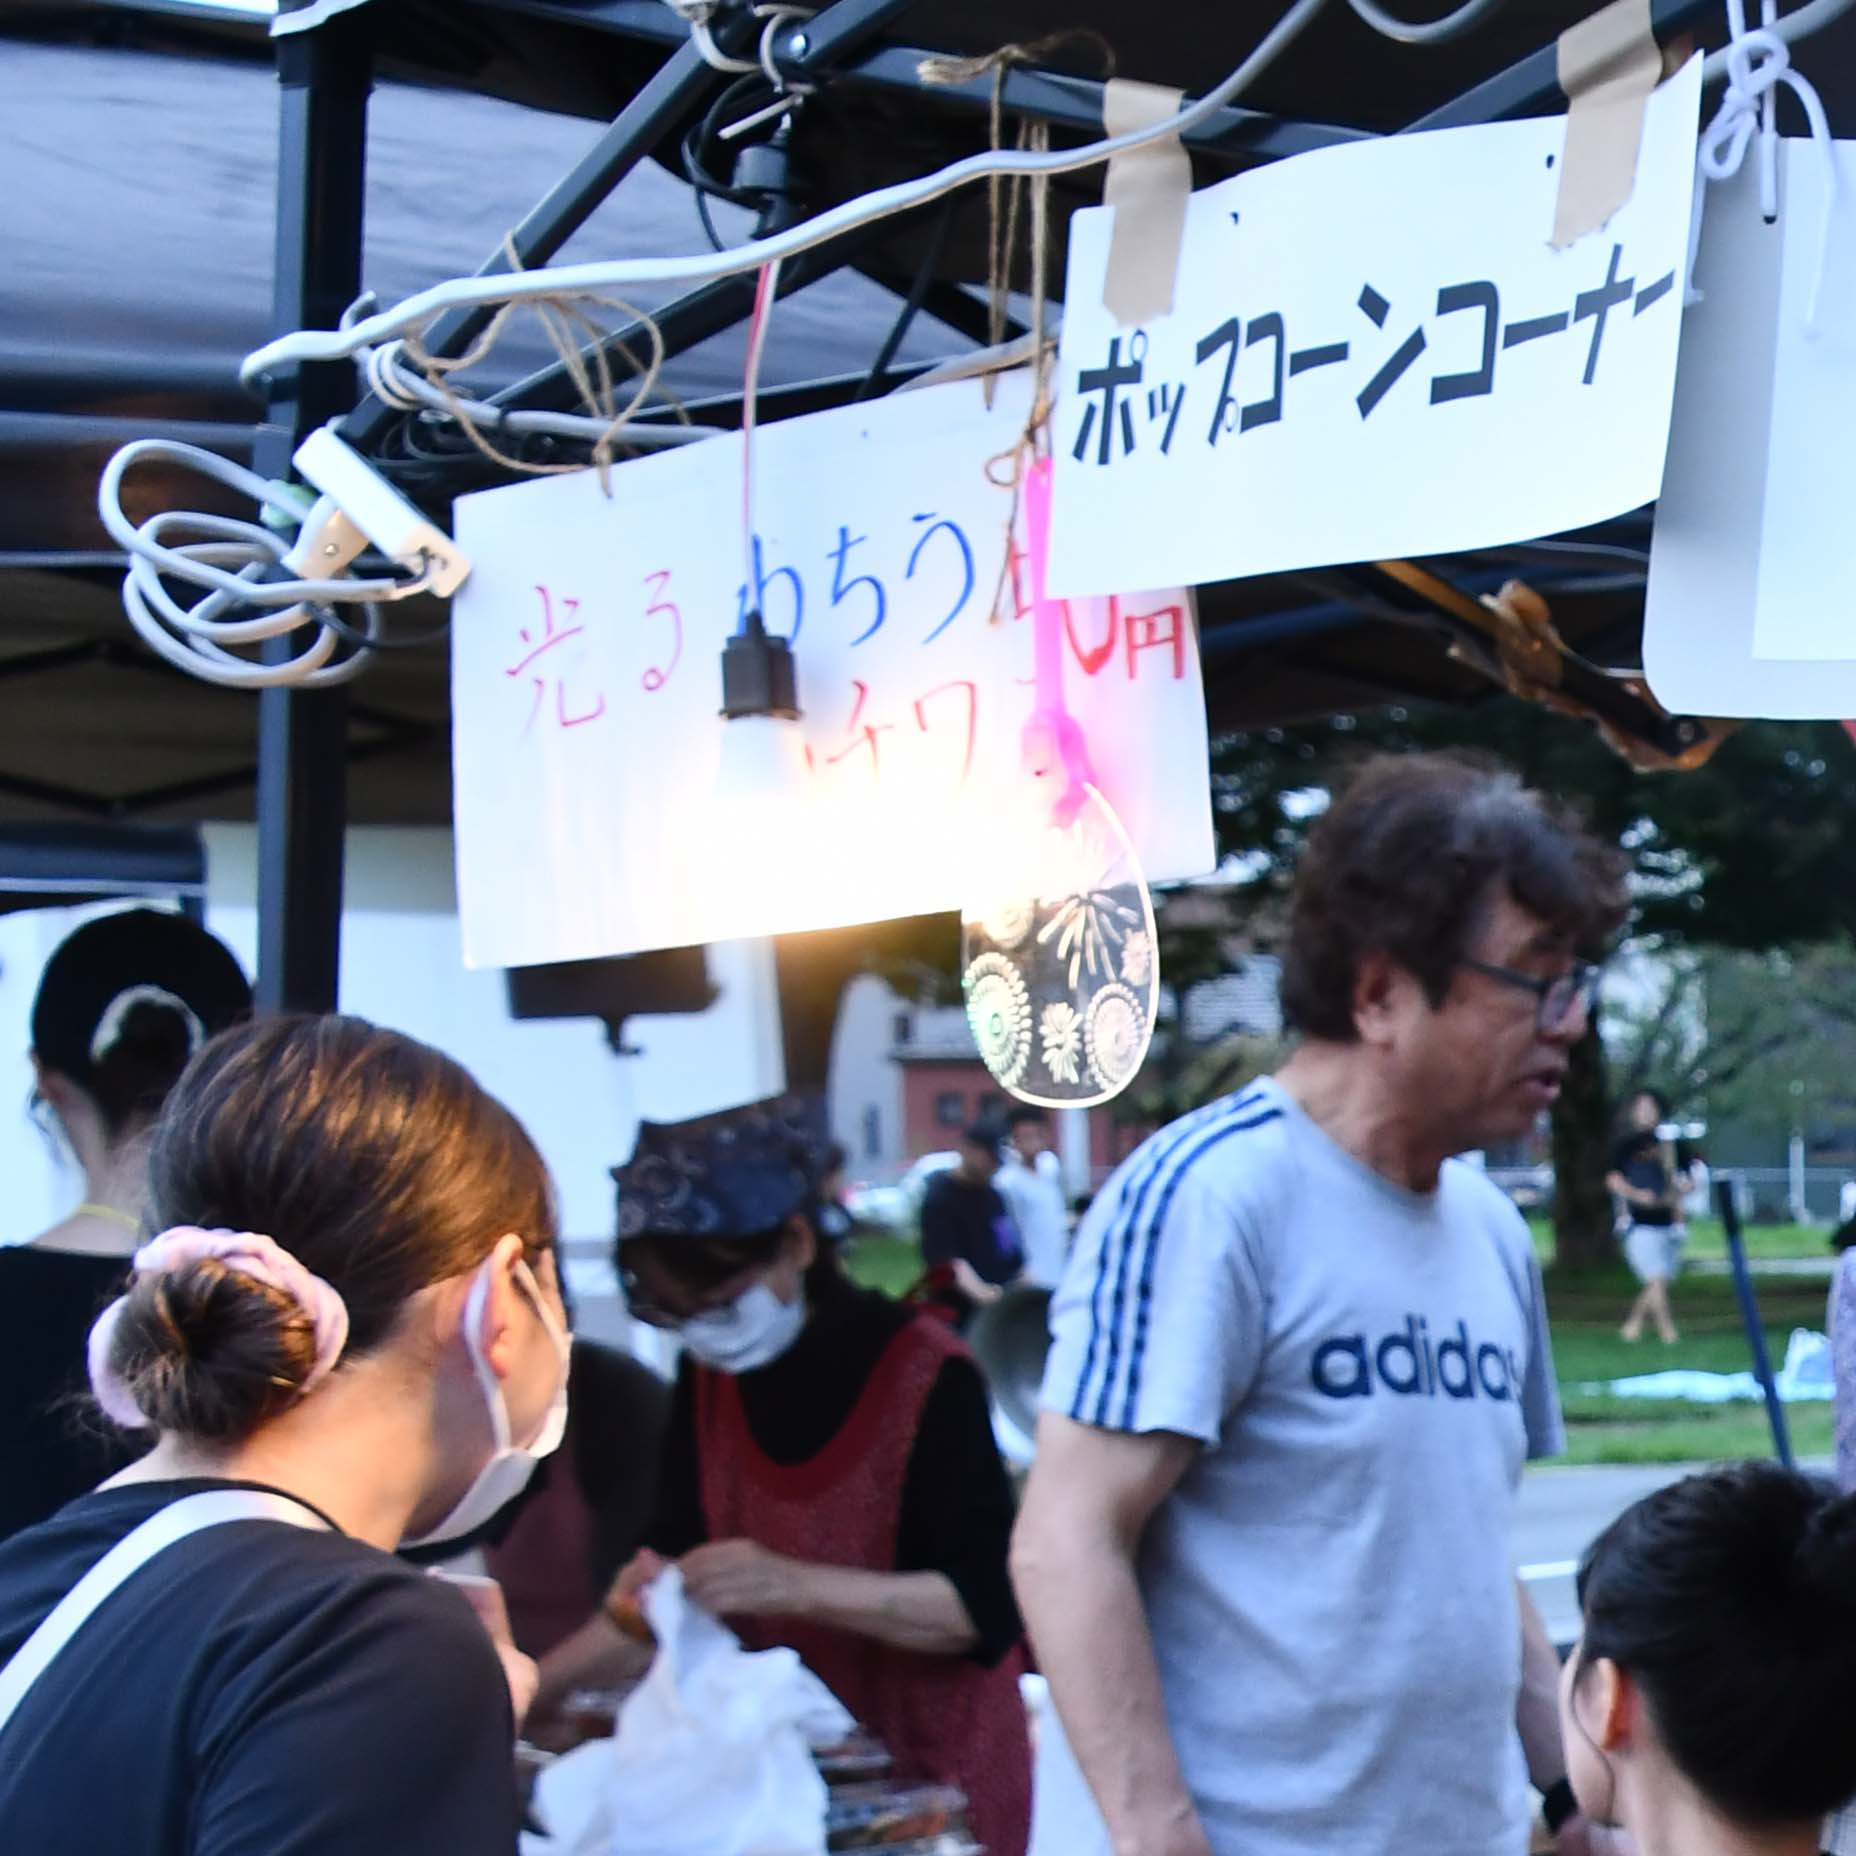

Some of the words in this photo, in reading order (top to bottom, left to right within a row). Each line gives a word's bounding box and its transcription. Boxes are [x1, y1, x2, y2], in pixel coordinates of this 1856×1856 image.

[1072, 244, 1675, 466] ポップコーンコーナー
